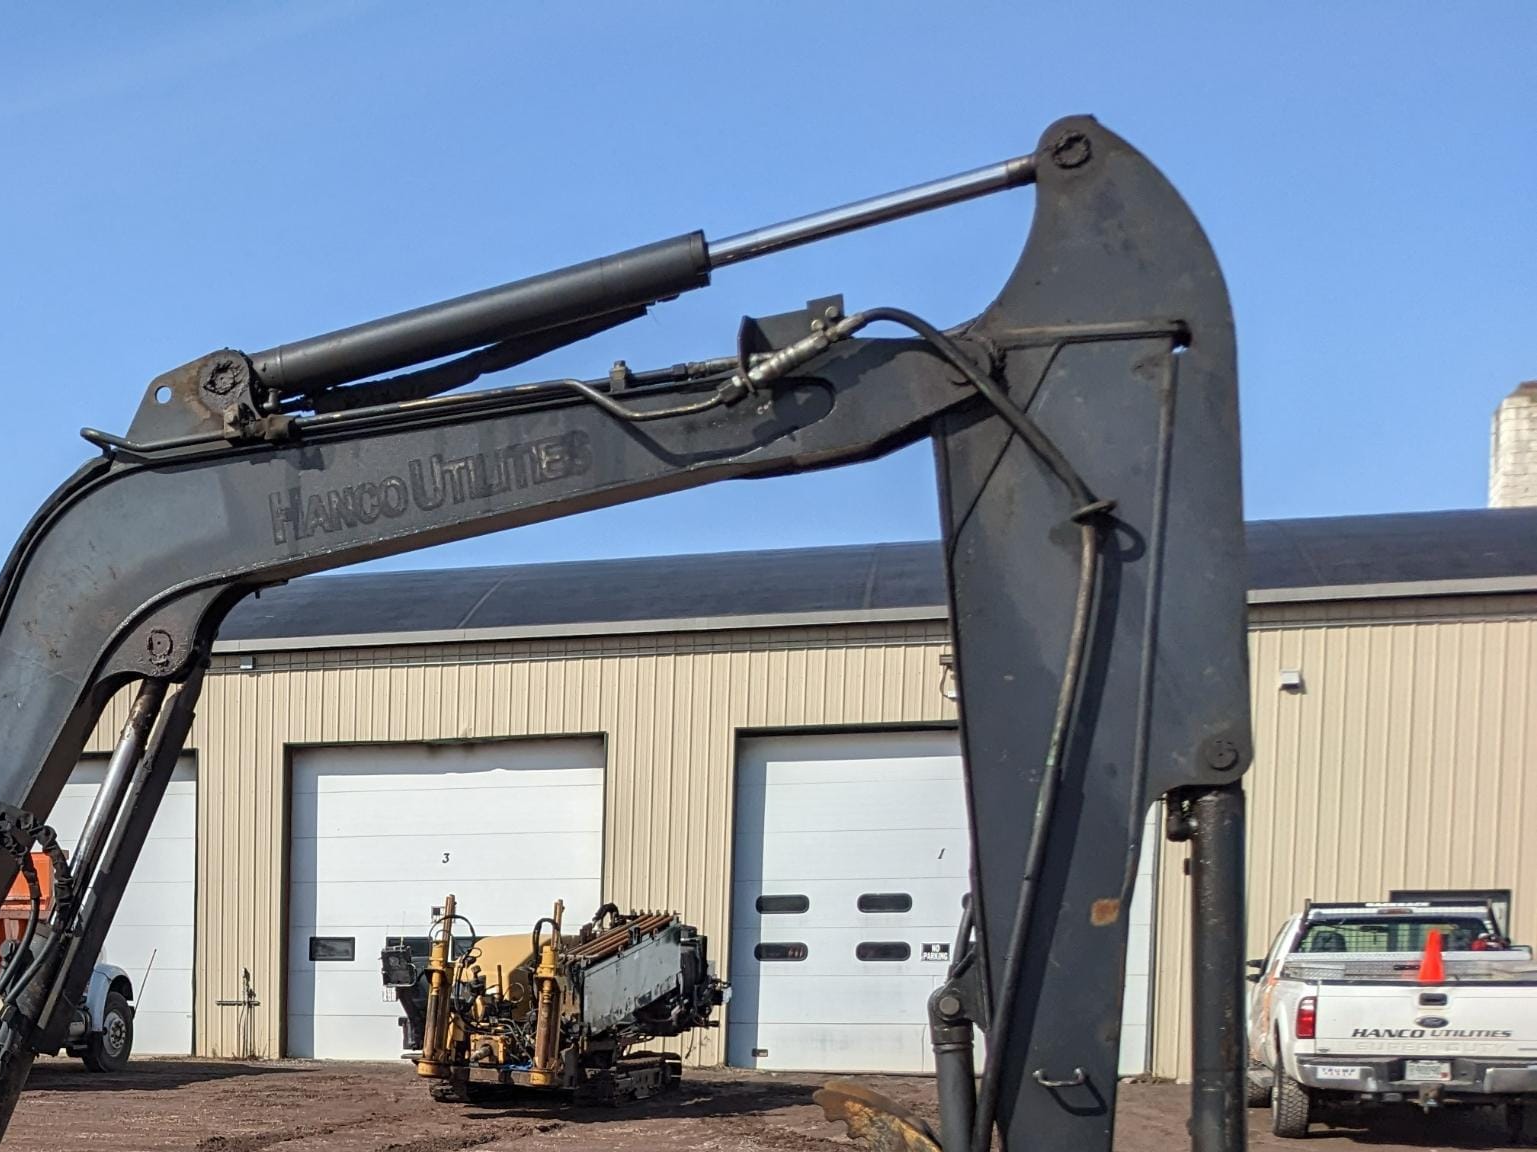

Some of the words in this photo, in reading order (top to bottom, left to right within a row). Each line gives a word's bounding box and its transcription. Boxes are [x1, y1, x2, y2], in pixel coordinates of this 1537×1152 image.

[441, 852, 450, 864] 3
[931, 943, 941, 953] NO
[923, 952, 948, 961] PARKING
[1351, 1028, 1425, 1039] HANCO
[1429, 1029, 1513, 1038] UTILITIES
